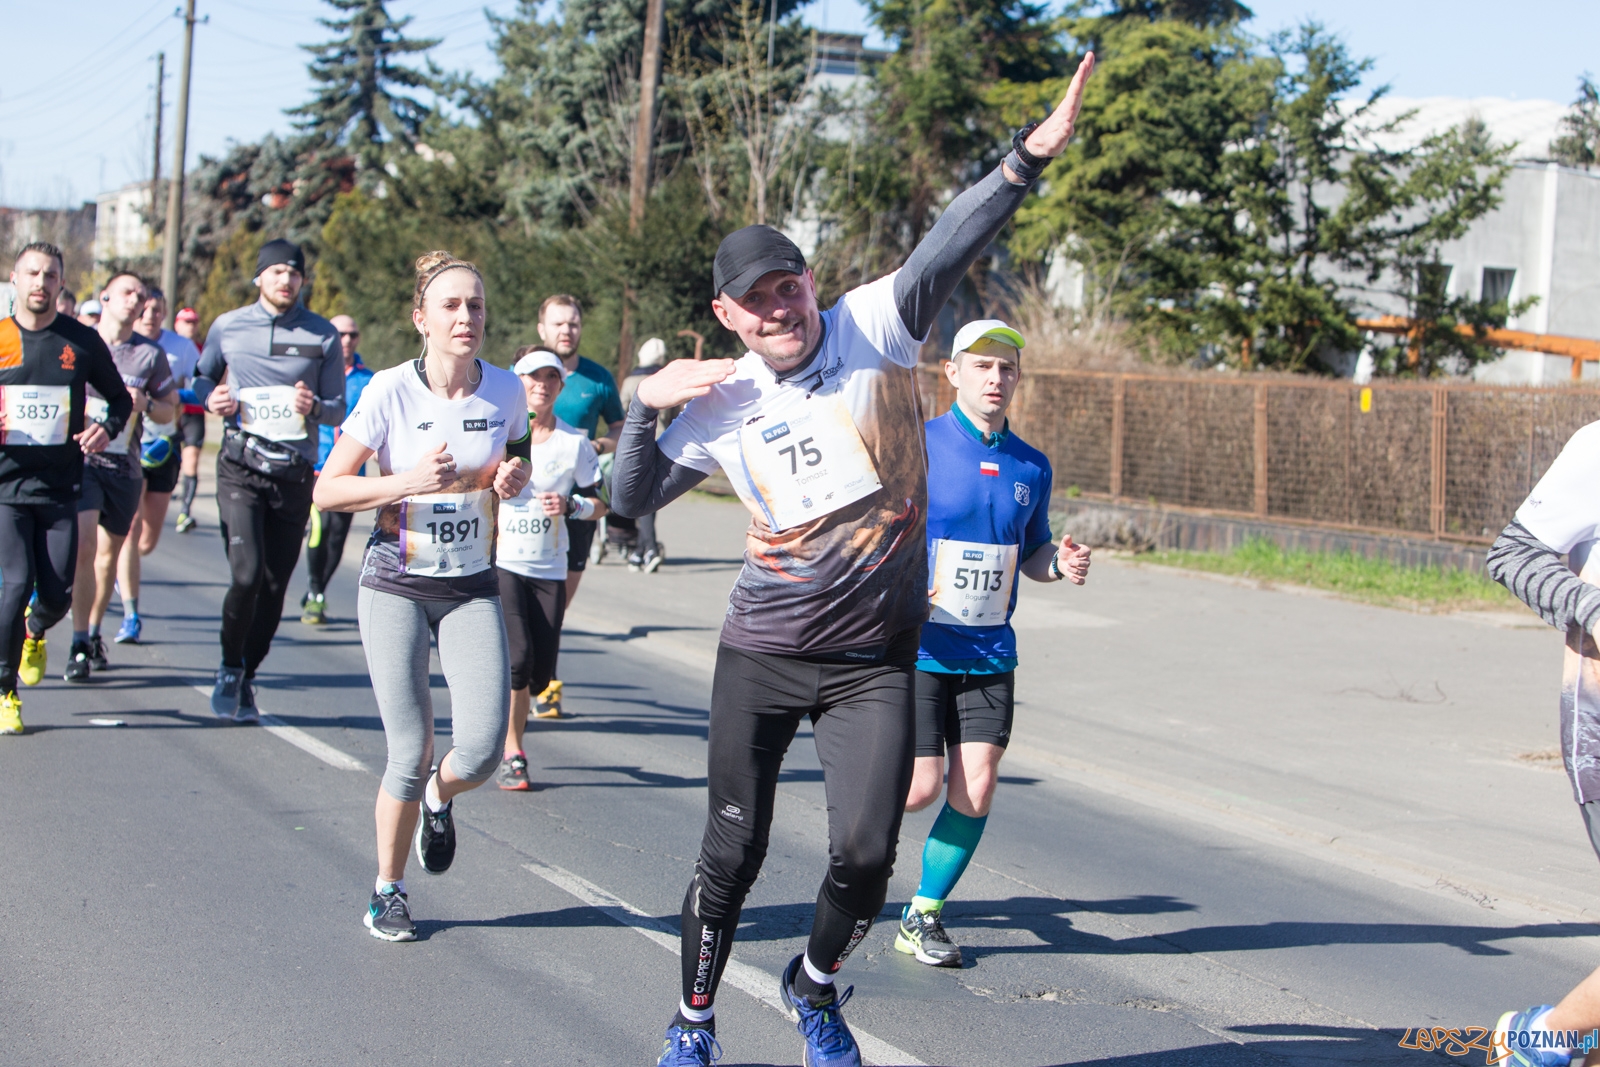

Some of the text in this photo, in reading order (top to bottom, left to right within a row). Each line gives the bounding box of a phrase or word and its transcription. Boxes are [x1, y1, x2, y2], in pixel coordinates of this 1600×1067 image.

[16, 404, 60, 420] 3837
[250, 404, 292, 420] 1056
[417, 421, 434, 431] 4F
[773, 425, 788, 436] PKO
[778, 436, 823, 475] 75
[795, 469, 829, 486] Tomasz
[426, 517, 479, 544] 1891
[505, 517, 552, 534] 4889
[953, 567, 1004, 592] 5113
